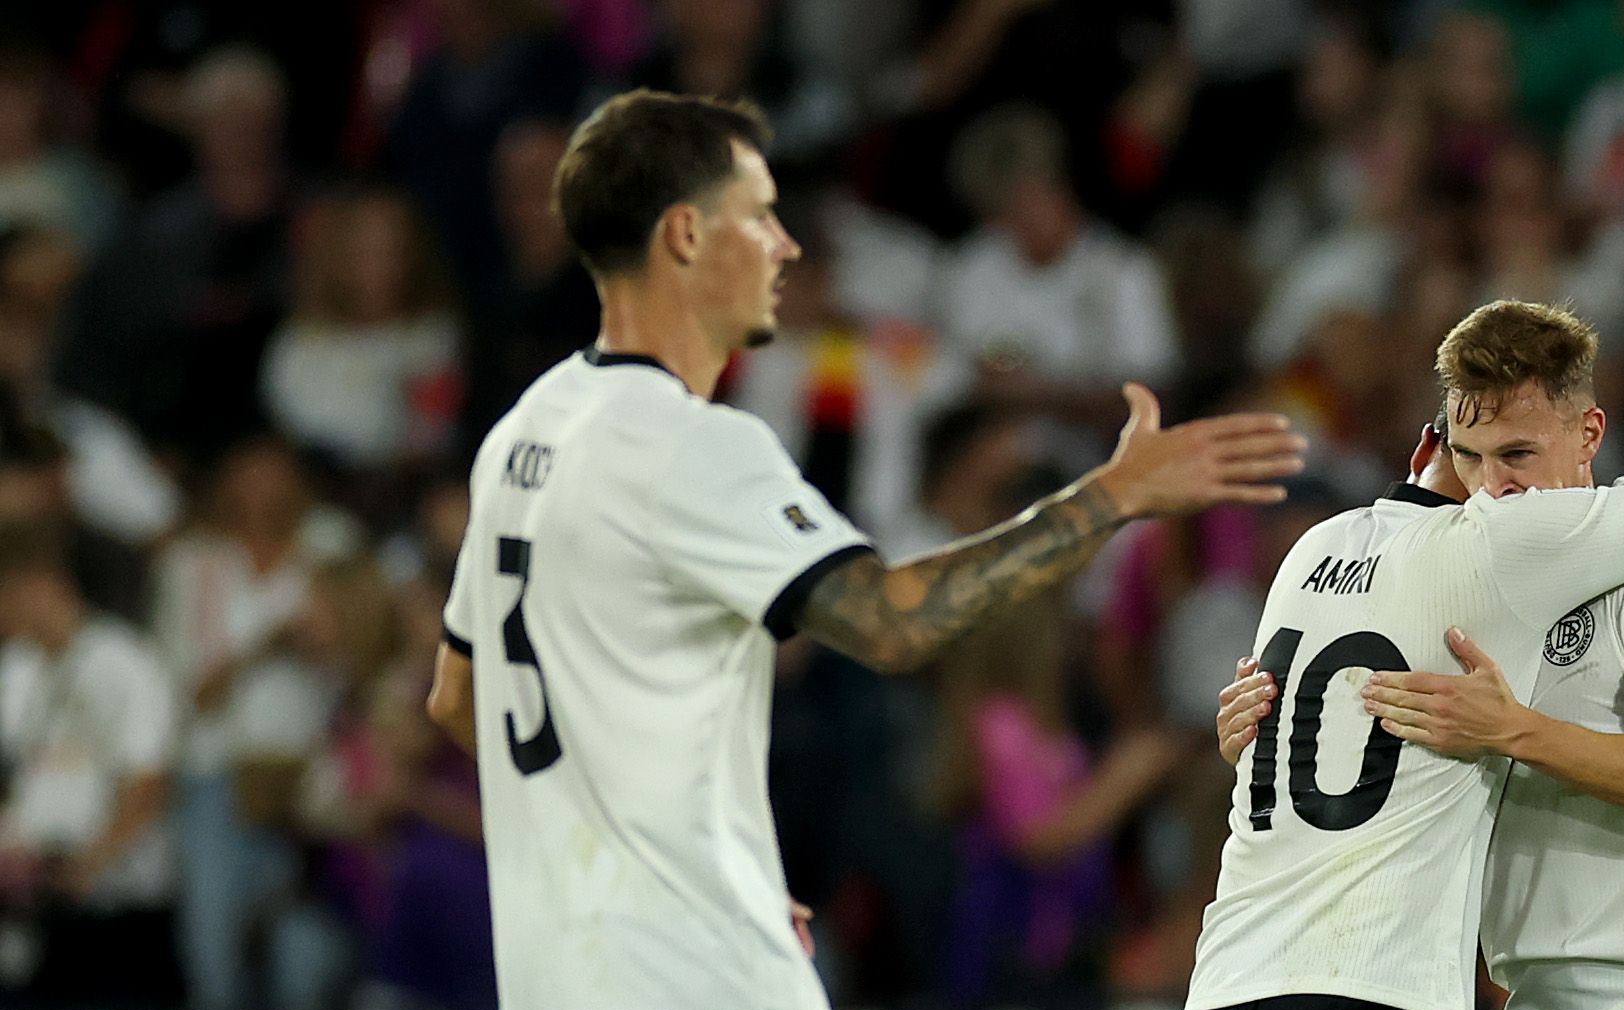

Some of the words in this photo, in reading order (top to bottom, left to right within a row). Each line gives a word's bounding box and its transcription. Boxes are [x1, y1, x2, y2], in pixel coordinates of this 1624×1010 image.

[497, 537, 562, 777] 3
[1300, 553, 1382, 595] AMIRI
[1249, 627, 1414, 831] 10
